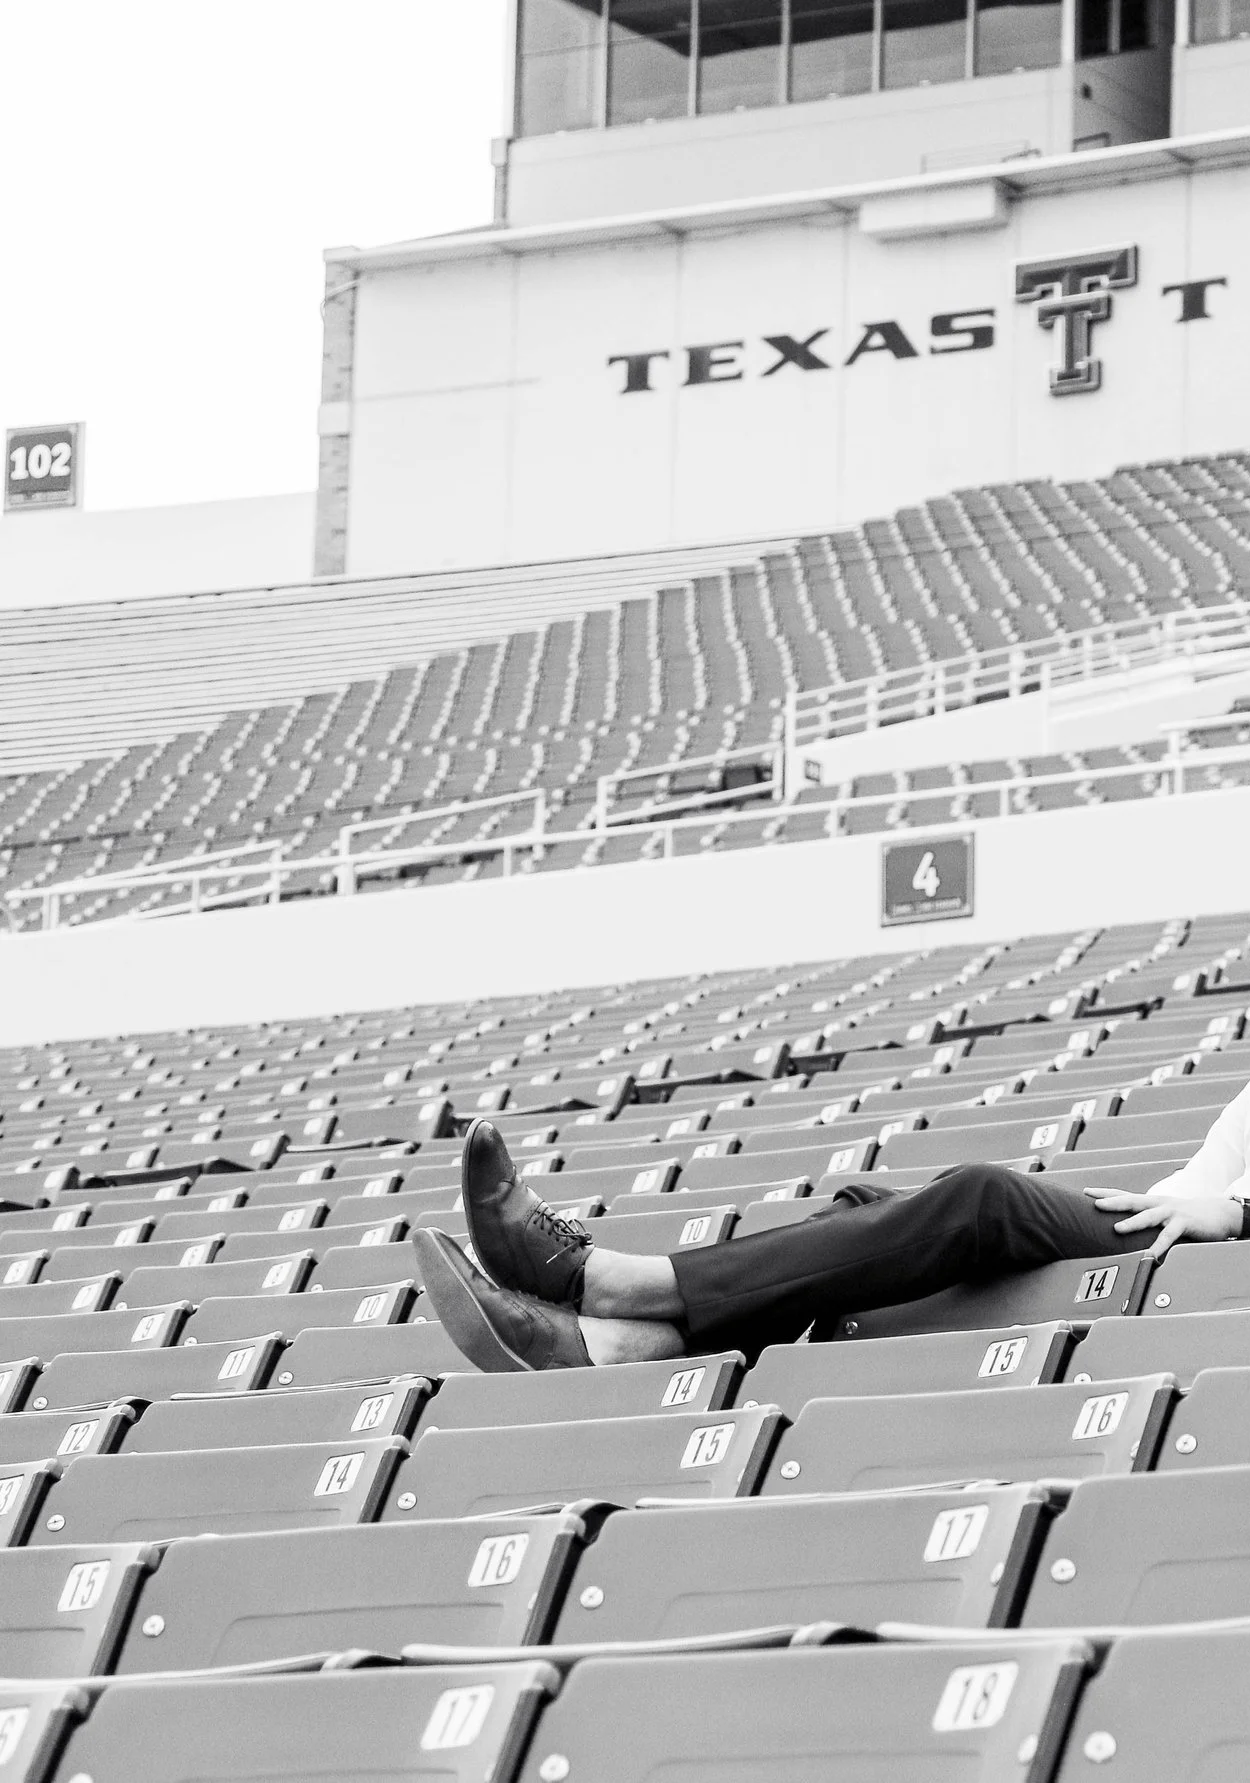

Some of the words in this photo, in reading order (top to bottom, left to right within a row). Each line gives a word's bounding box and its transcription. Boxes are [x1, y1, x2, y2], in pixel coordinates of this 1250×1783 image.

[607, 308, 996, 394] TEXAS
[10, 442, 72, 480] 102
[912, 851, 940, 897] 4
[686, 1220, 704, 1242] 10
[1084, 1270, 1108, 1299] 14
[360, 1296, 380, 1320] 10
[141, 1317, 154, 1338] 9
[226, 1351, 247, 1376] 11
[988, 1342, 1018, 1374] 15
[671, 1372, 696, 1403] 14
[360, 1398, 384, 1428] 13
[1083, 1398, 1116, 1435] 16
[65, 1424, 90, 1451] 12
[692, 1428, 724, 1464] 15
[325, 1458, 353, 1492] 14
[939, 1513, 975, 1557] 17
[481, 1540, 516, 1582] 16
[69, 1567, 100, 1607] 15
[953, 1672, 998, 1724] 18
[439, 1694, 478, 1741] 17
